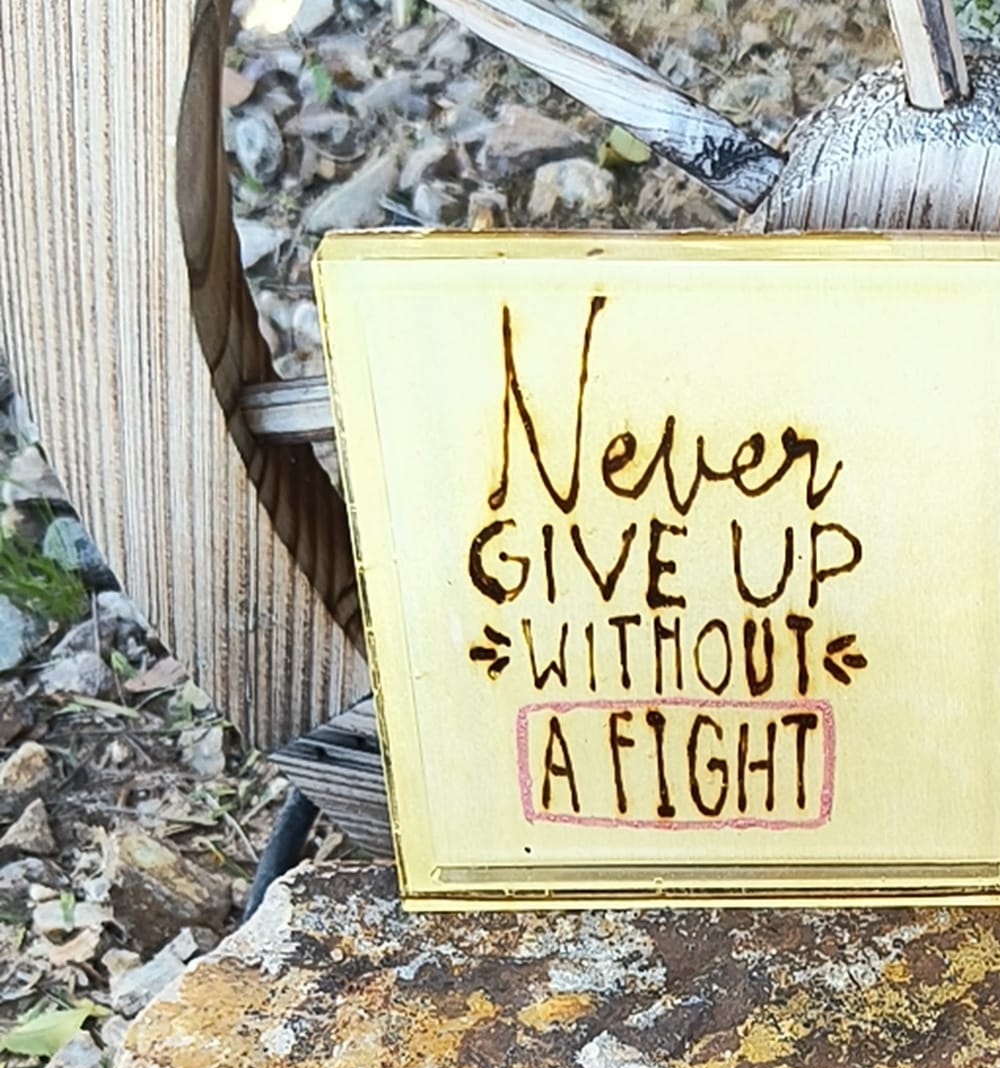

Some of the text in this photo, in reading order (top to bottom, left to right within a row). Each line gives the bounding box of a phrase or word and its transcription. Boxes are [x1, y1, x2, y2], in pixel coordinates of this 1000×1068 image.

[488, 295, 844, 516] Never
[468, 519, 863, 610] GIVE UP
[520, 613, 815, 697] WITHOUT
[542, 709, 819, 819] A FIGHT
